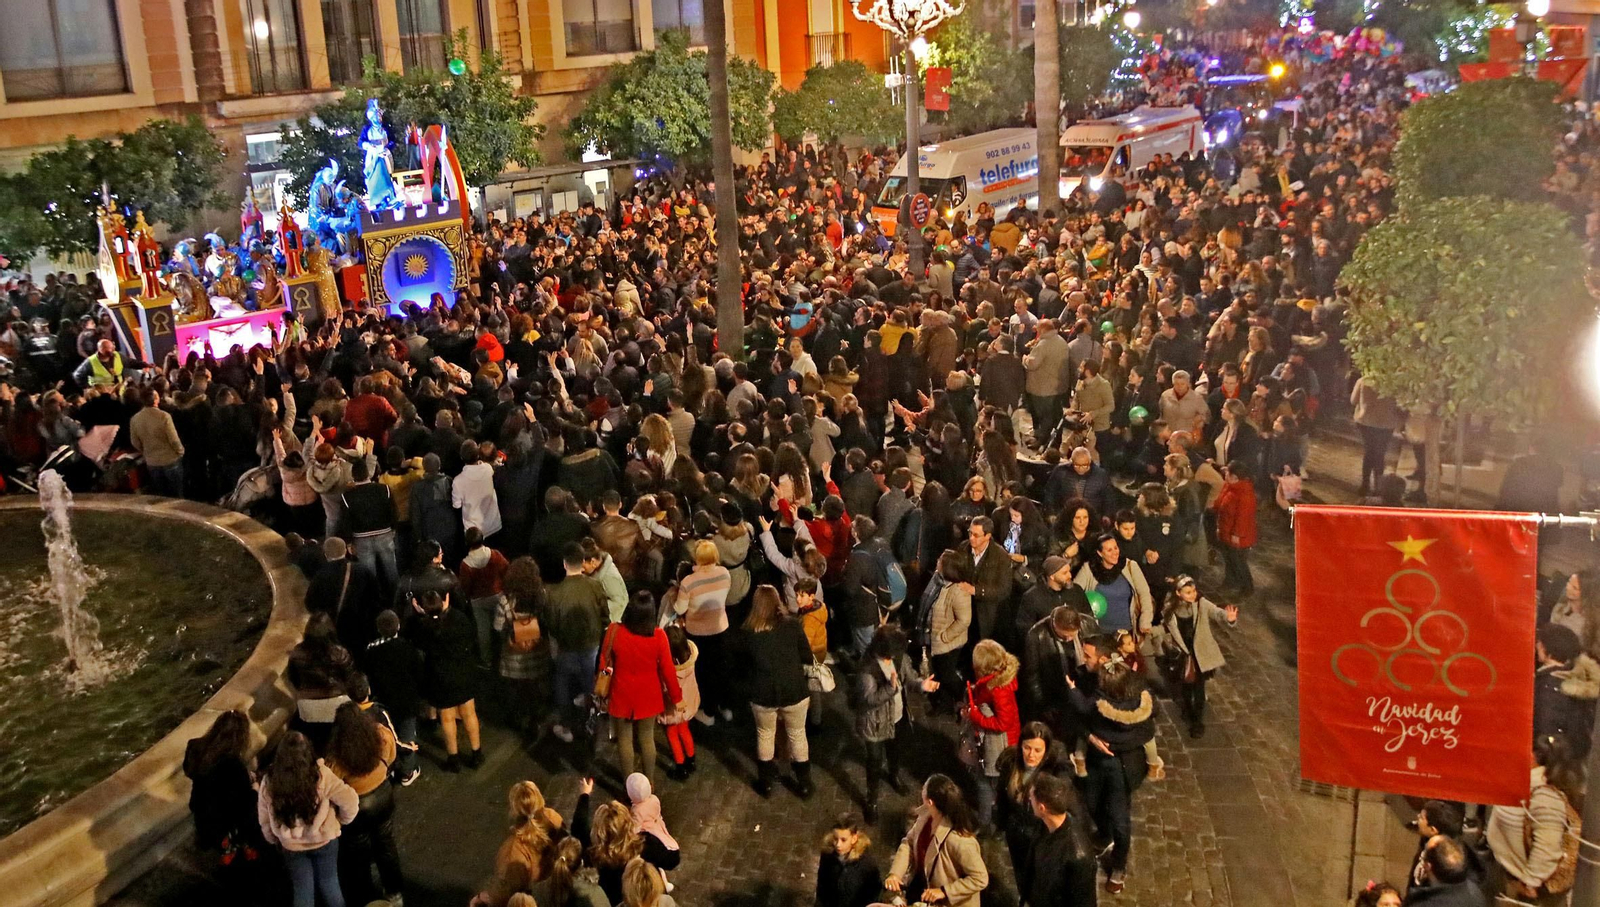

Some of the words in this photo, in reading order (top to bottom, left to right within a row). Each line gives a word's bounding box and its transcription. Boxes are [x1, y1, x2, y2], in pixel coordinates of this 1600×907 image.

[986, 150, 999, 159] 902
[1001, 146, 1010, 155] 88
[1012, 144, 1020, 153] 99
[1022, 142, 1030, 150] 43
[1010, 195, 1018, 203] de
[1366, 696, 1462, 725] Navidad
[1373, 726, 1387, 734] en
[1384, 717, 1460, 752] Jerez
